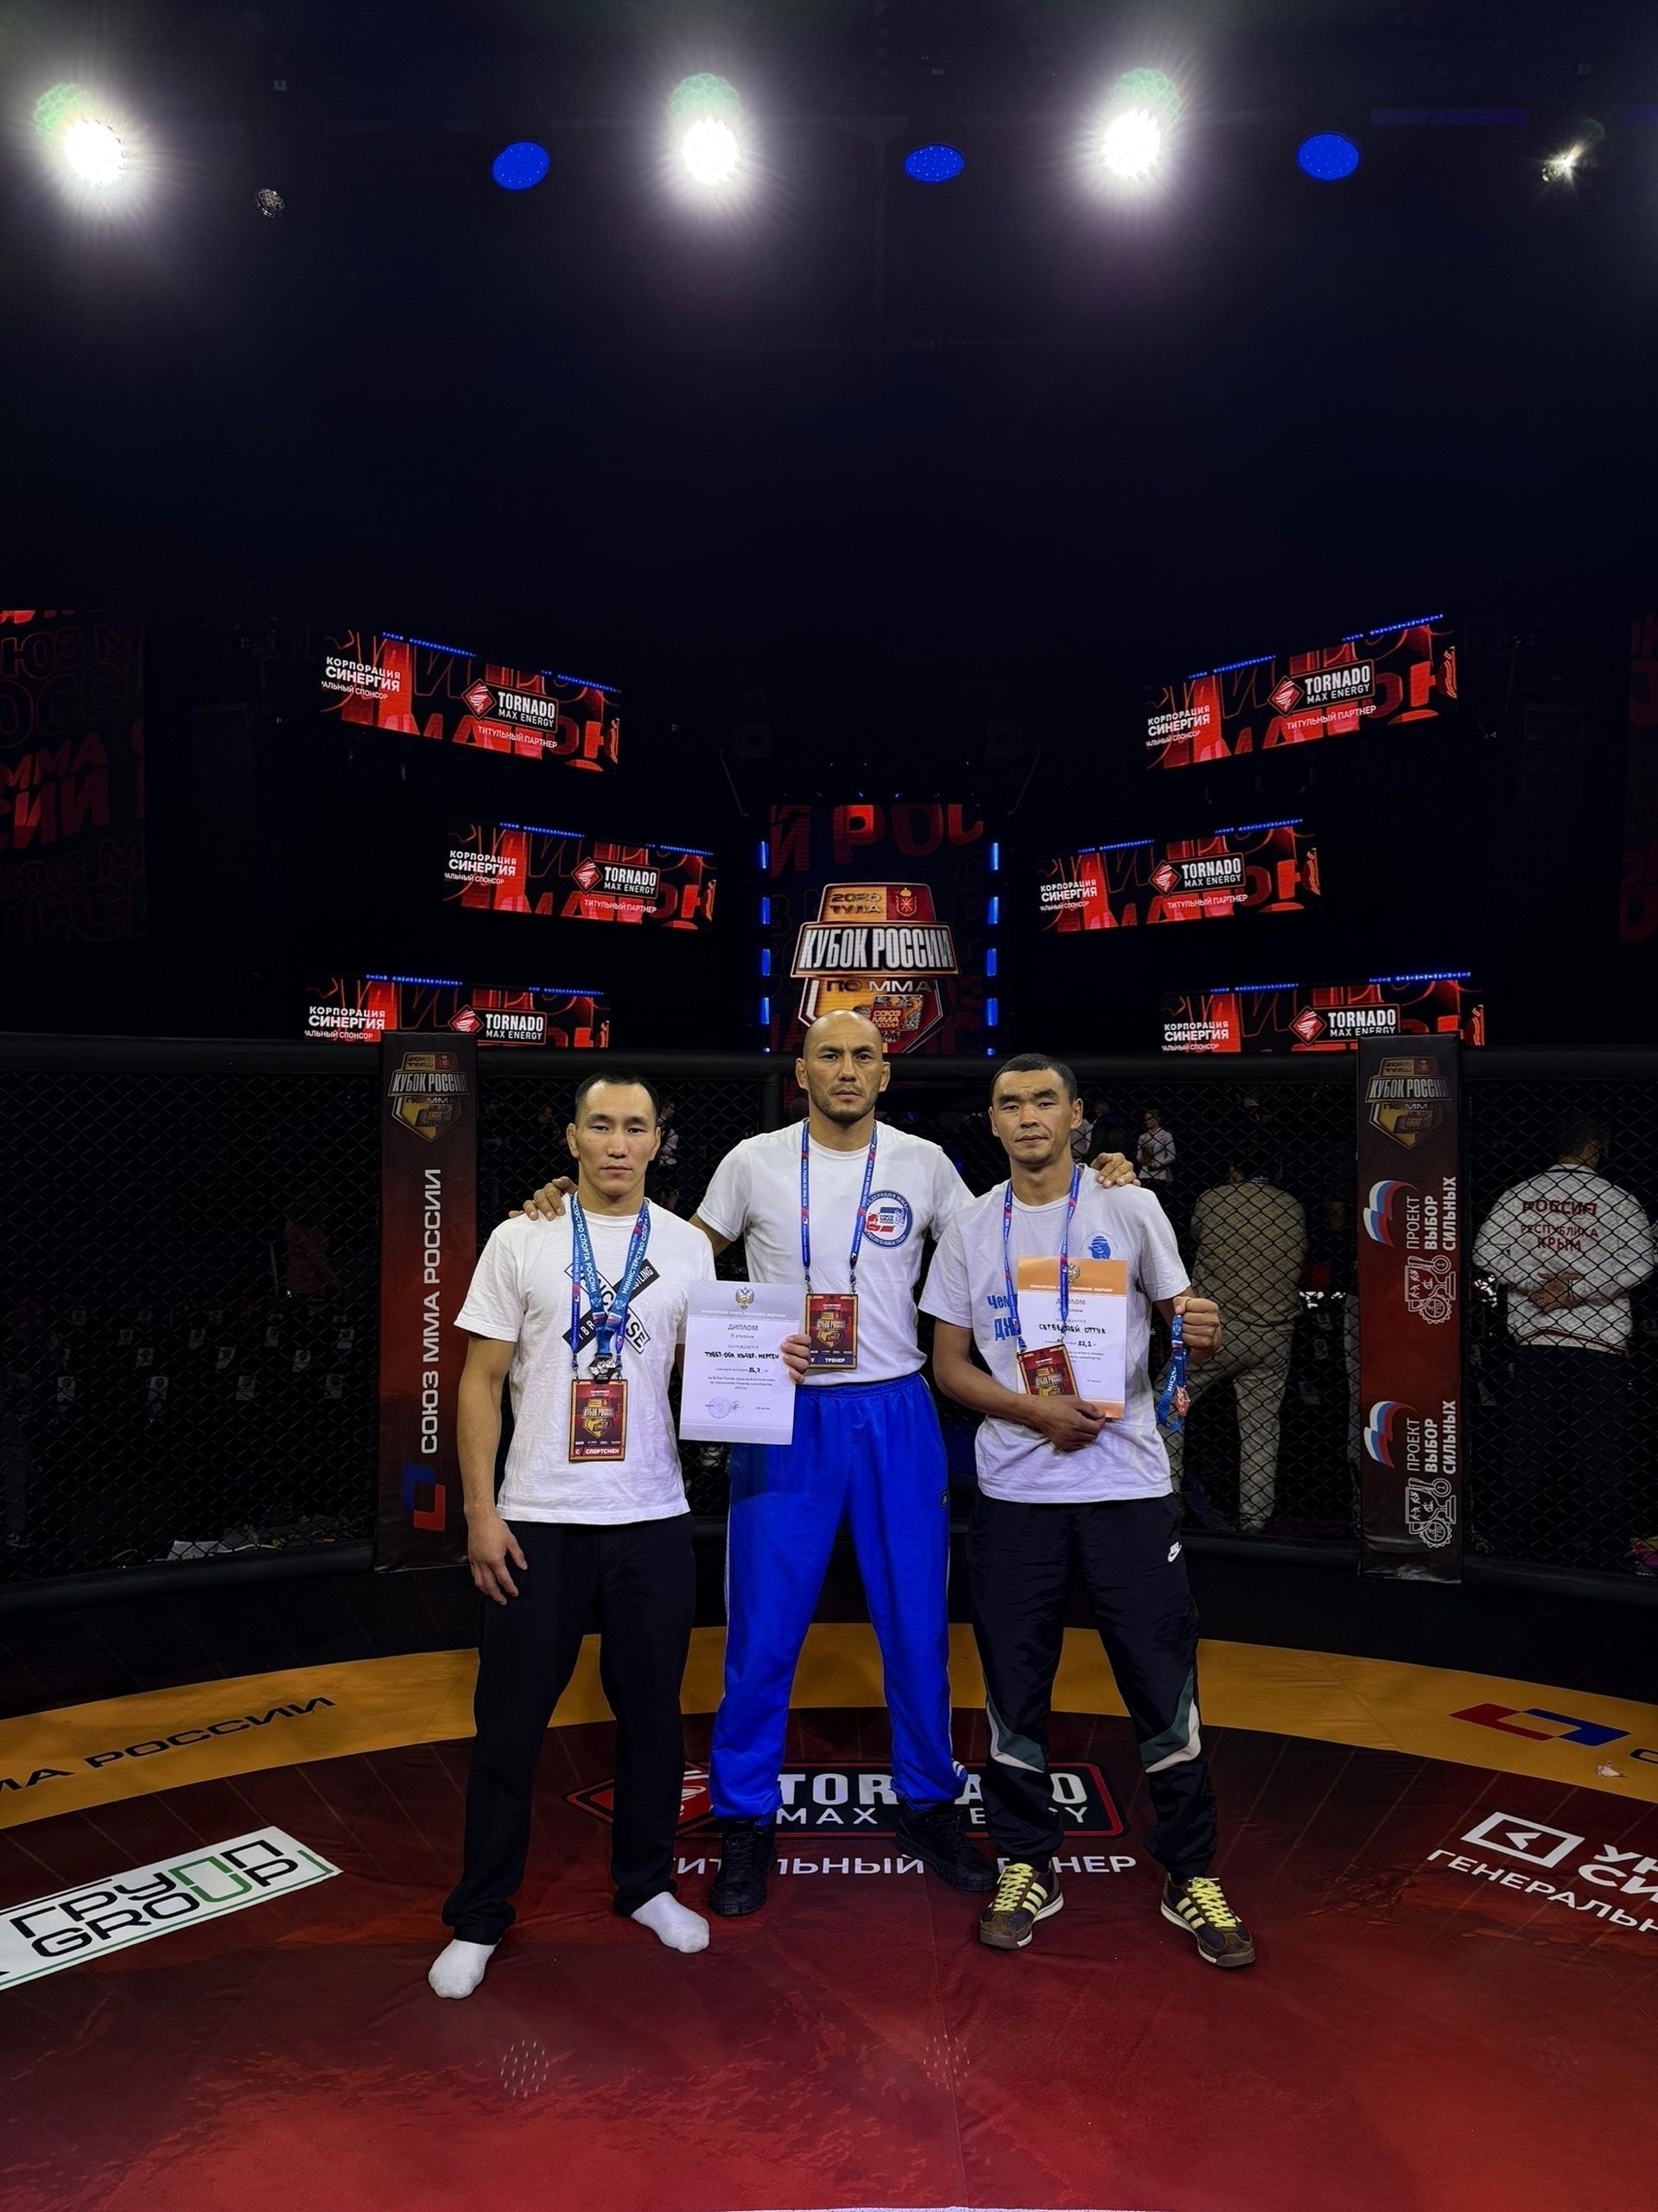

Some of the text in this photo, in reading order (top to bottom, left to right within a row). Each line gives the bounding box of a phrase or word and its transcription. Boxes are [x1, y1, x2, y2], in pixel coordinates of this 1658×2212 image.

[326, 657, 401, 680] КОРПОРАЦИЯ
[325, 666, 401, 692] СИНЕРГИЯ
[1305, 665, 1370, 696] TORNADO
[355, 686, 389, 700] СПОНСОР
[1306, 683, 1370, 704] MAX ENERGY
[498, 691, 556, 719] TORNADO
[499, 709, 554, 728] MAX ENERGY
[1147, 705, 1210, 726] КОРПОРАЦИЯ
[1286, 705, 1377, 731] ТИТУЛЬНЫЙ ПАРТНЕР
[1148, 714, 1210, 737] СИНЕРГИЯ
[478, 726, 557, 749] ТИТУЛЬНЫЙ ПАРТНЕР
[1172, 730, 1202, 741] СПОНСОР
[450, 850, 517, 865] КОРПОРАЦИЯ
[448, 859, 516, 876] СИНЕРГИЯ
[604, 867, 657, 887] TORNADO
[1181, 858, 1242, 880] TORNADO
[474, 875, 505, 885] СПОНСОР
[604, 882, 655, 894] MAX ENERGY
[1040, 879, 1096, 892] КОРПОРАЦИЯ
[1184, 874, 1242, 888] MAX ENERGY
[1041, 887, 1097, 902] СИНЕРГИЯ
[1167, 894, 1248, 910] ТИТУЛЬНЫЙ ПАРТНЕР
[584, 899, 657, 913] ТИТУЛЬНЫЙ ПАРТНЕР
[829, 905, 881, 913] ТУЛА
[1064, 900, 1089, 909] СПОНСОР
[798, 927, 955, 969] КУБОК РОССИИ
[826, 980, 932, 993] ПО ММА
[308, 1015, 384, 1029] СИНЕРГИЯ
[309, 1007, 385, 1018] КОРПОРАЦИЯ
[1328, 1009, 1396, 1028] TORNADO
[486, 1014, 543, 1032] TORNADO
[1164, 1020, 1229, 1031] КОРПОРАЦИЯ
[1330, 1028, 1353, 1037] MAX
[339, 1031, 373, 1040] СПОНСОР
[486, 1030, 543, 1041] MAX ENERGY
[1165, 1028, 1229, 1042] СИНЕРГИЯ
[1190, 1042, 1220, 1051] СПОНСОР
[392, 1073, 426, 1092] КУБОК
[1369, 1079, 1405, 1098] КУБОК
[1407, 1196, 1420, 1249] ПРОЕКТ
[1425, 1195, 1438, 1250] ВЫБОР
[1443, 1176, 1457, 1251] СИЛЬНЫХ
[1521, 1224, 1599, 1237] РСПБЛИА
[1538, 1236, 1581, 1251] КРЫМ
[580, 1233, 591, 1262] СПОРТА
[586, 1262, 597, 1293] РОССИИ
[622, 1242, 645, 1294] МИНИСТЕРСТВО
[421, 1168, 441, 1454] СОЮЗ ММА РОССИИ
[1407, 1418, 1420, 1471] ПРОЕКТ
[1425, 1418, 1439, 1473] ВЫБОР
[1443, 1400, 1457, 1475] СИЛЬНЫХ
[84, 1696, 337, 1769] РОССИИ
[777, 1772, 1087, 1805] TORAO
[776, 1807, 878, 1825] MAX
